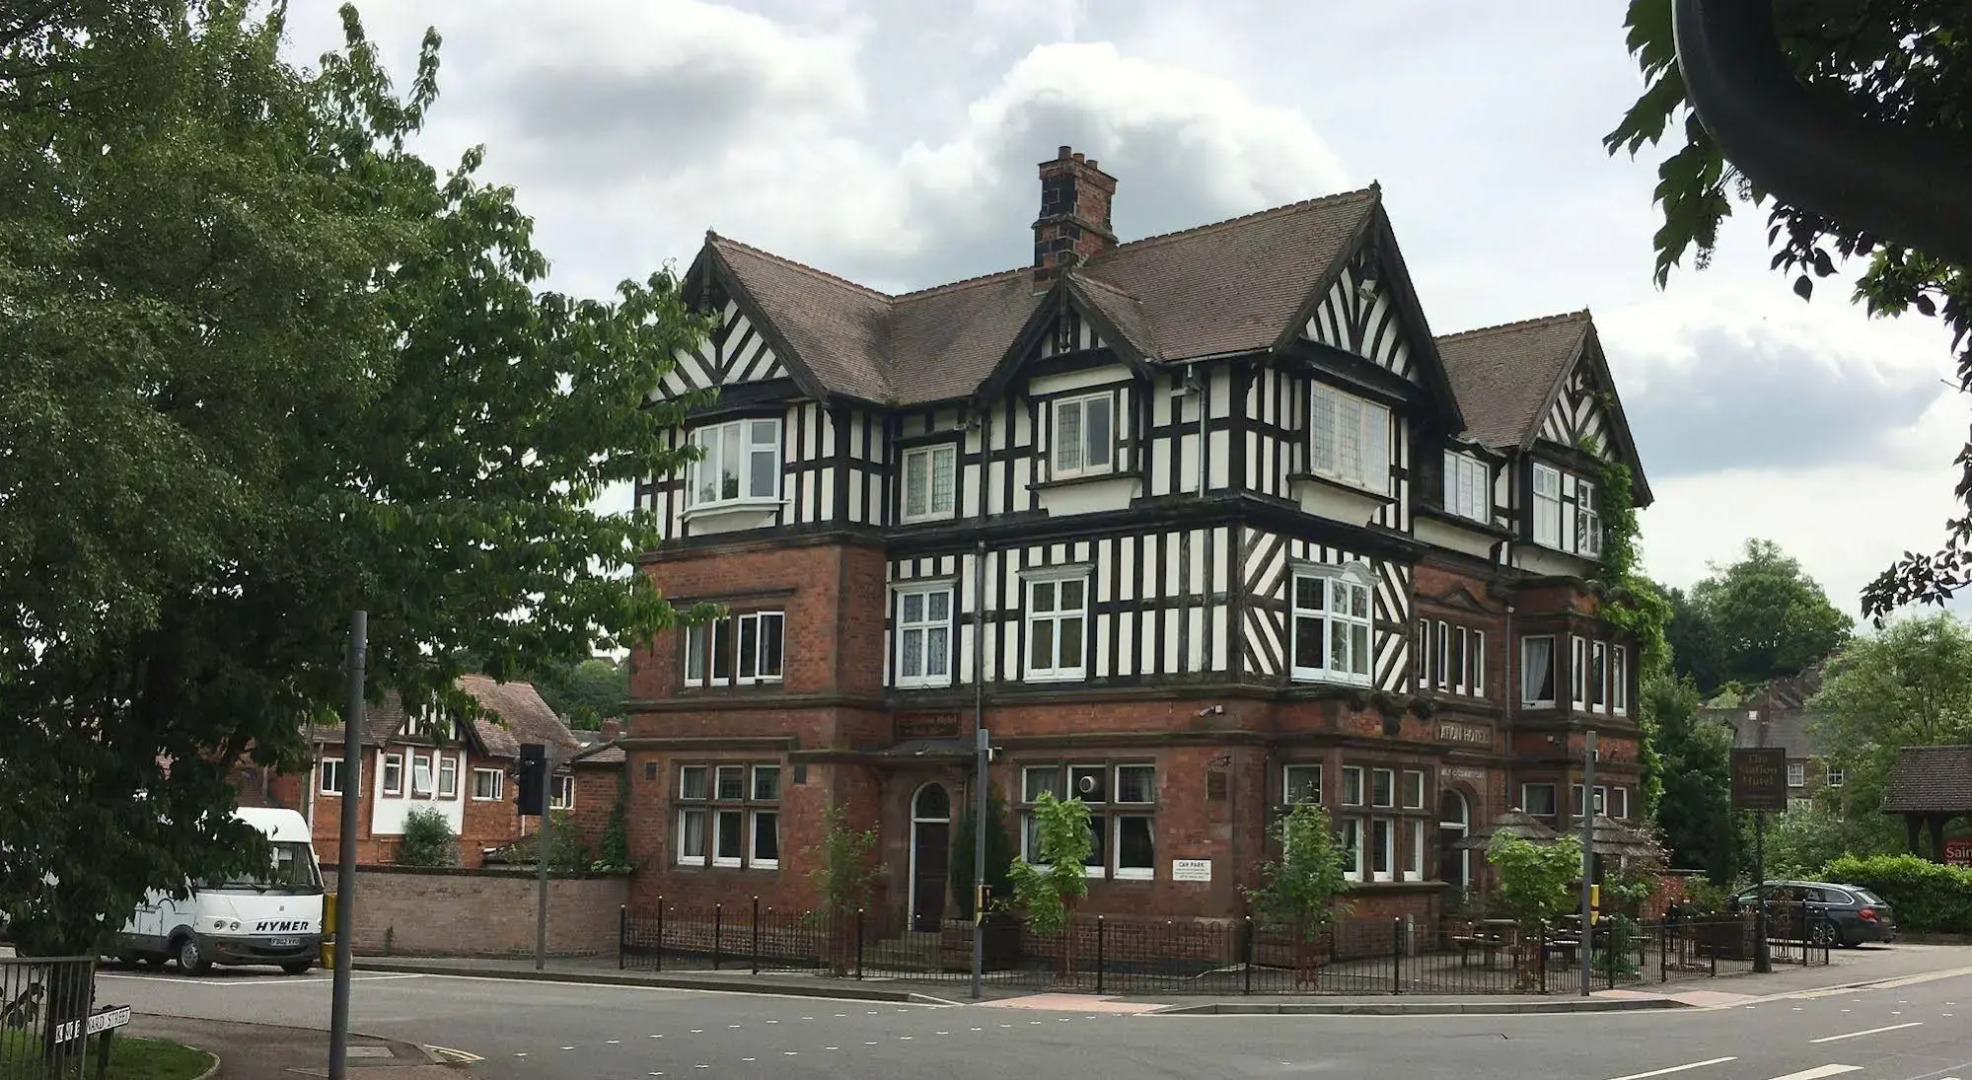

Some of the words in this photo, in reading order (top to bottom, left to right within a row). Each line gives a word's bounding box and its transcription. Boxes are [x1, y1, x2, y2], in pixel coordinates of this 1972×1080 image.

[1464, 728, 1488, 743] HOTEL
[256, 921, 309, 931] HYMER
[106, 1008, 130, 1028] STREET
